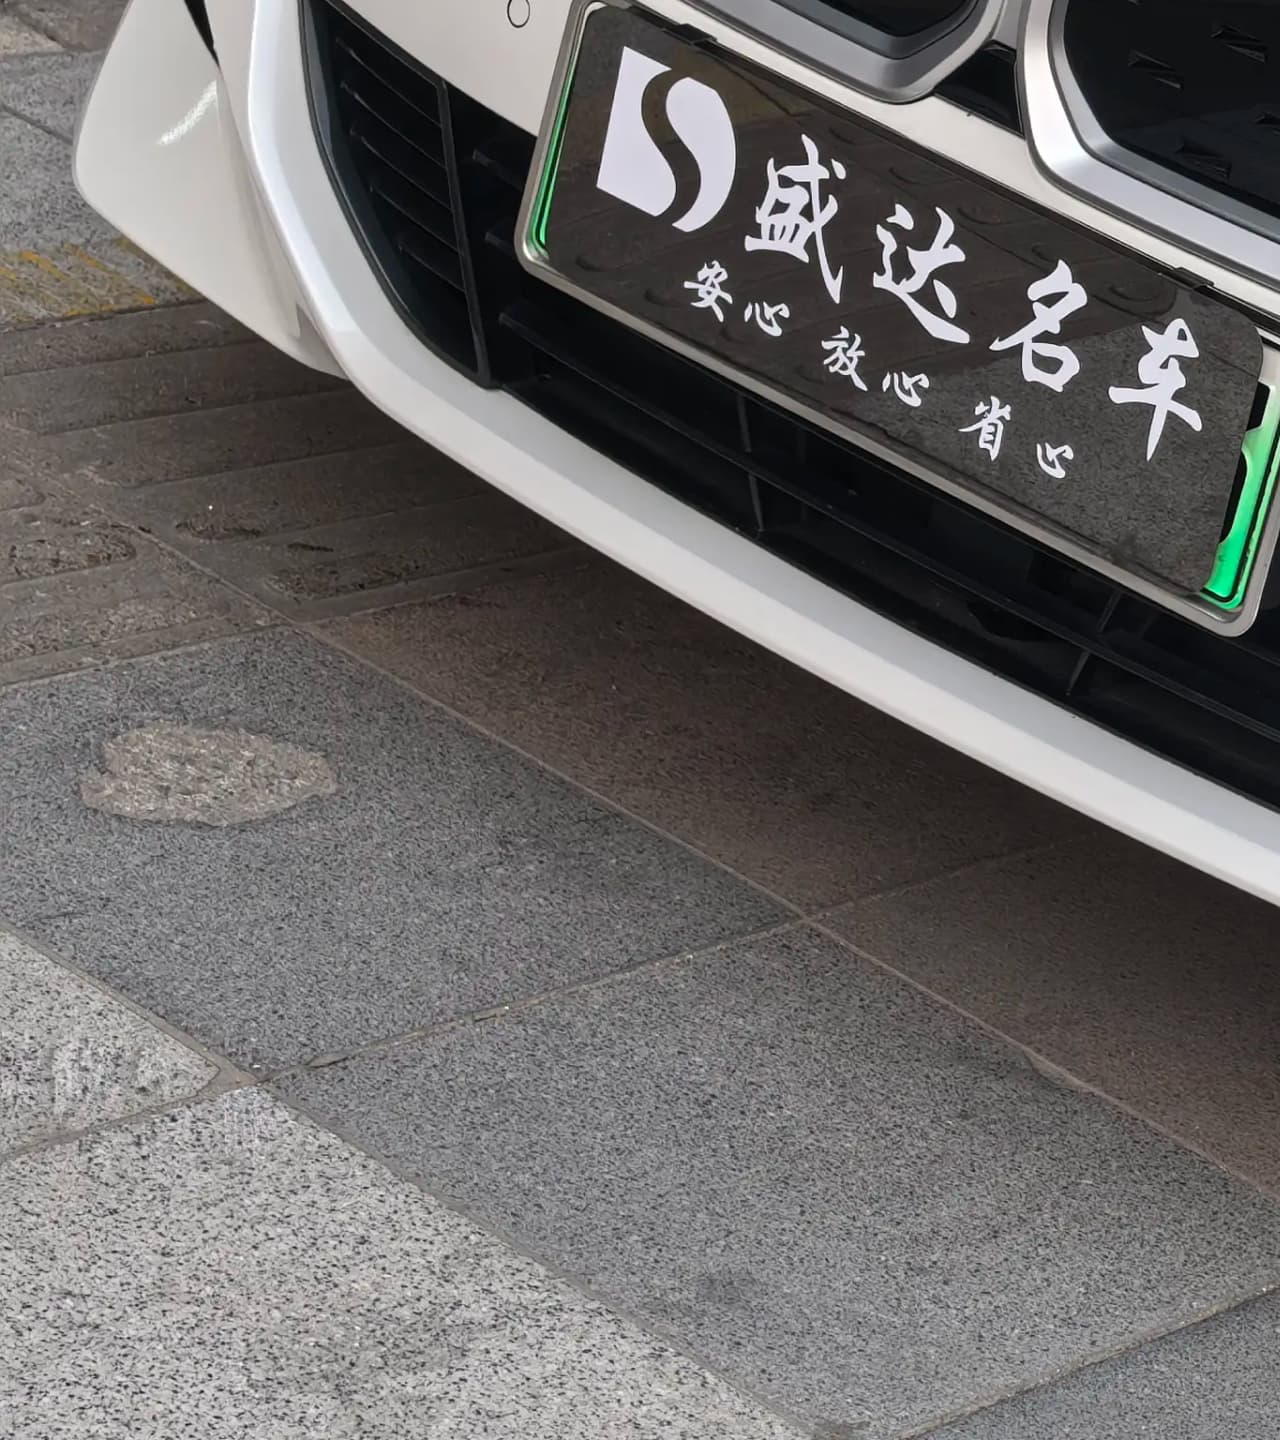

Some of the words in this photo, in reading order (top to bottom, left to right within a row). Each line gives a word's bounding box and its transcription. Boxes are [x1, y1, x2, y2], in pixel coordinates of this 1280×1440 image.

[684, 261, 789, 336] 安心
[822, 326, 929, 406] 放心
[959, 396, 1073, 478] 省心
[745, 134, 1202, 461] 盛达名车
